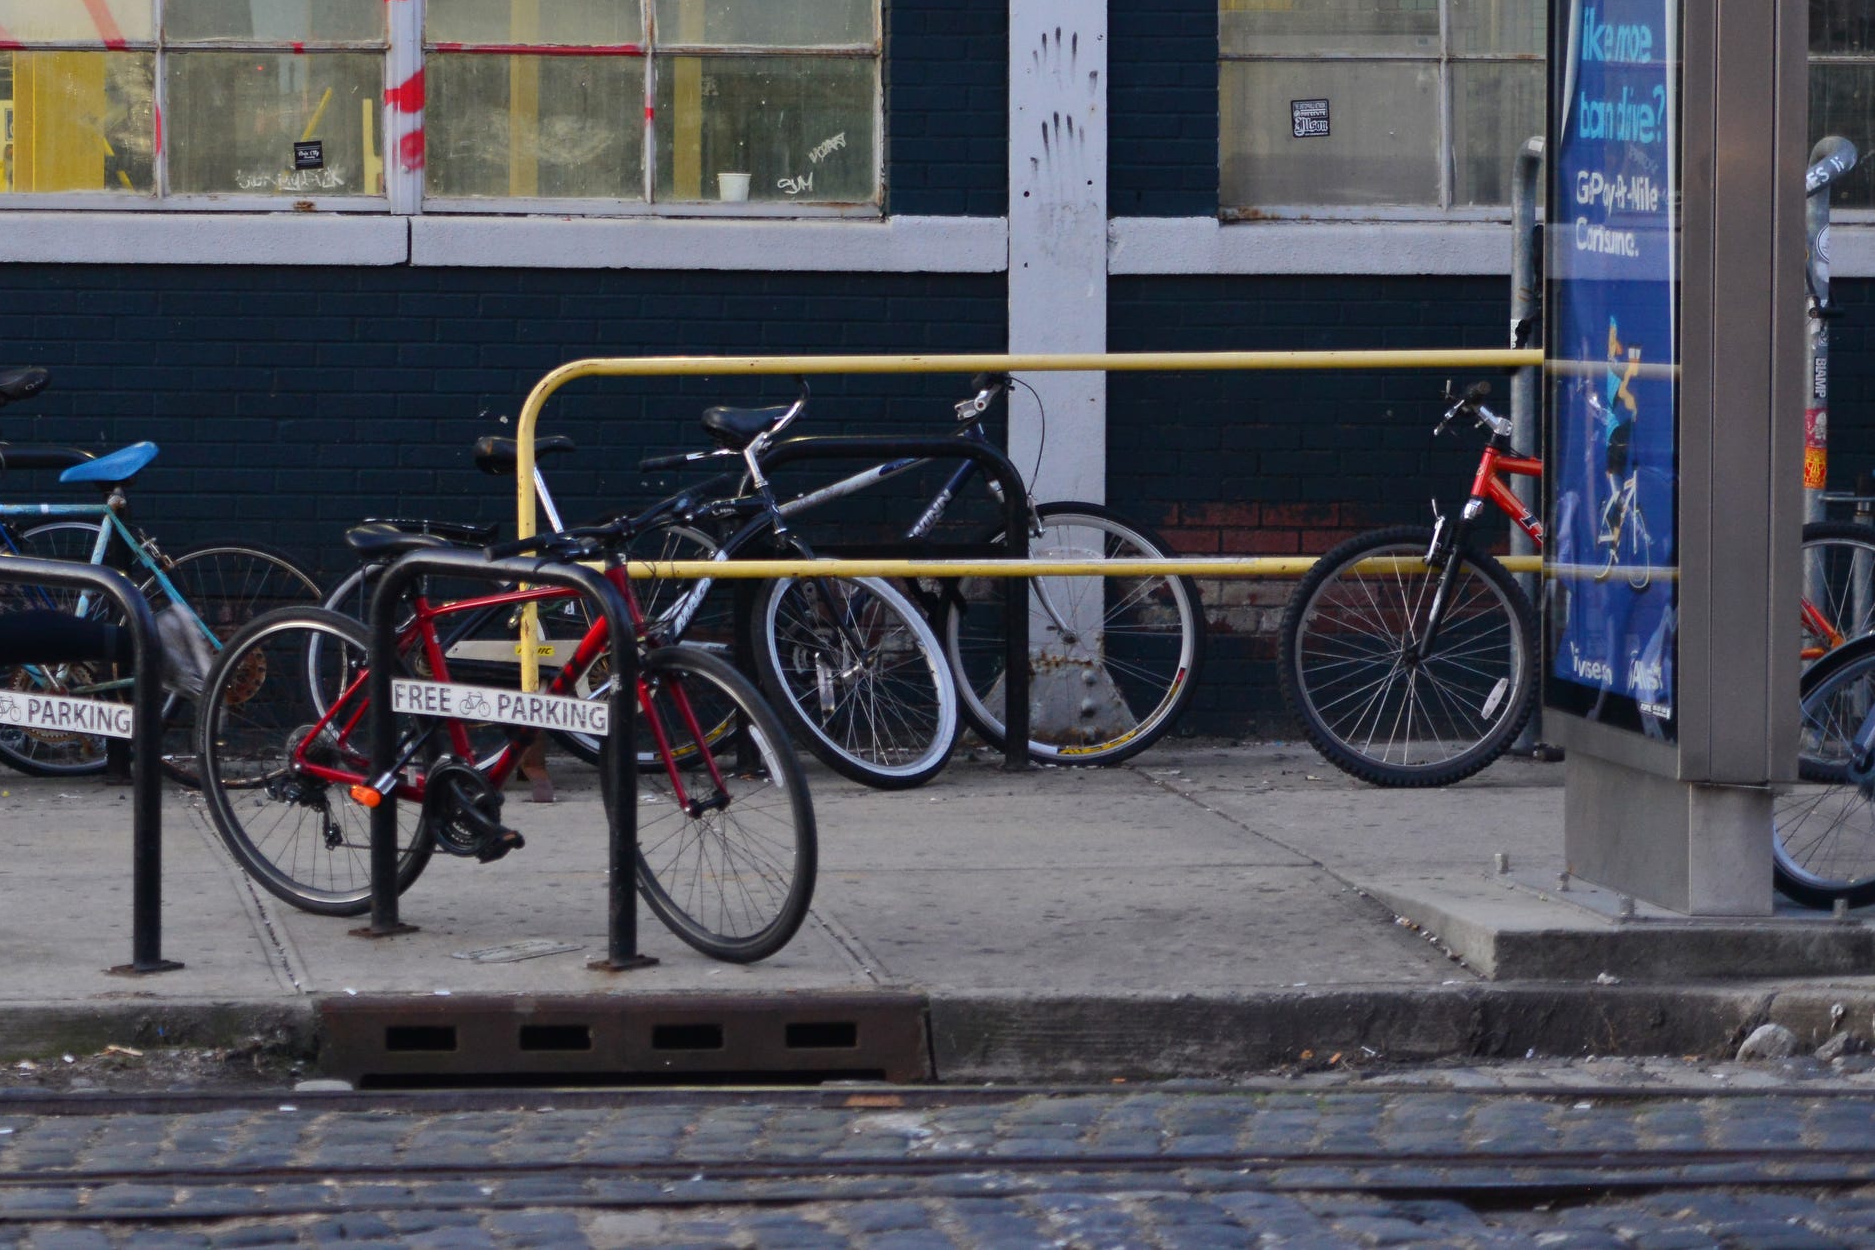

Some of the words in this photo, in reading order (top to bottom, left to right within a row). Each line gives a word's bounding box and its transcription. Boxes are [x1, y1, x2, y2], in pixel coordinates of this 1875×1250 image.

[28, 698, 131, 735] PARKING
[395, 684, 452, 712] FREE
[497, 694, 607, 731] PARKING
